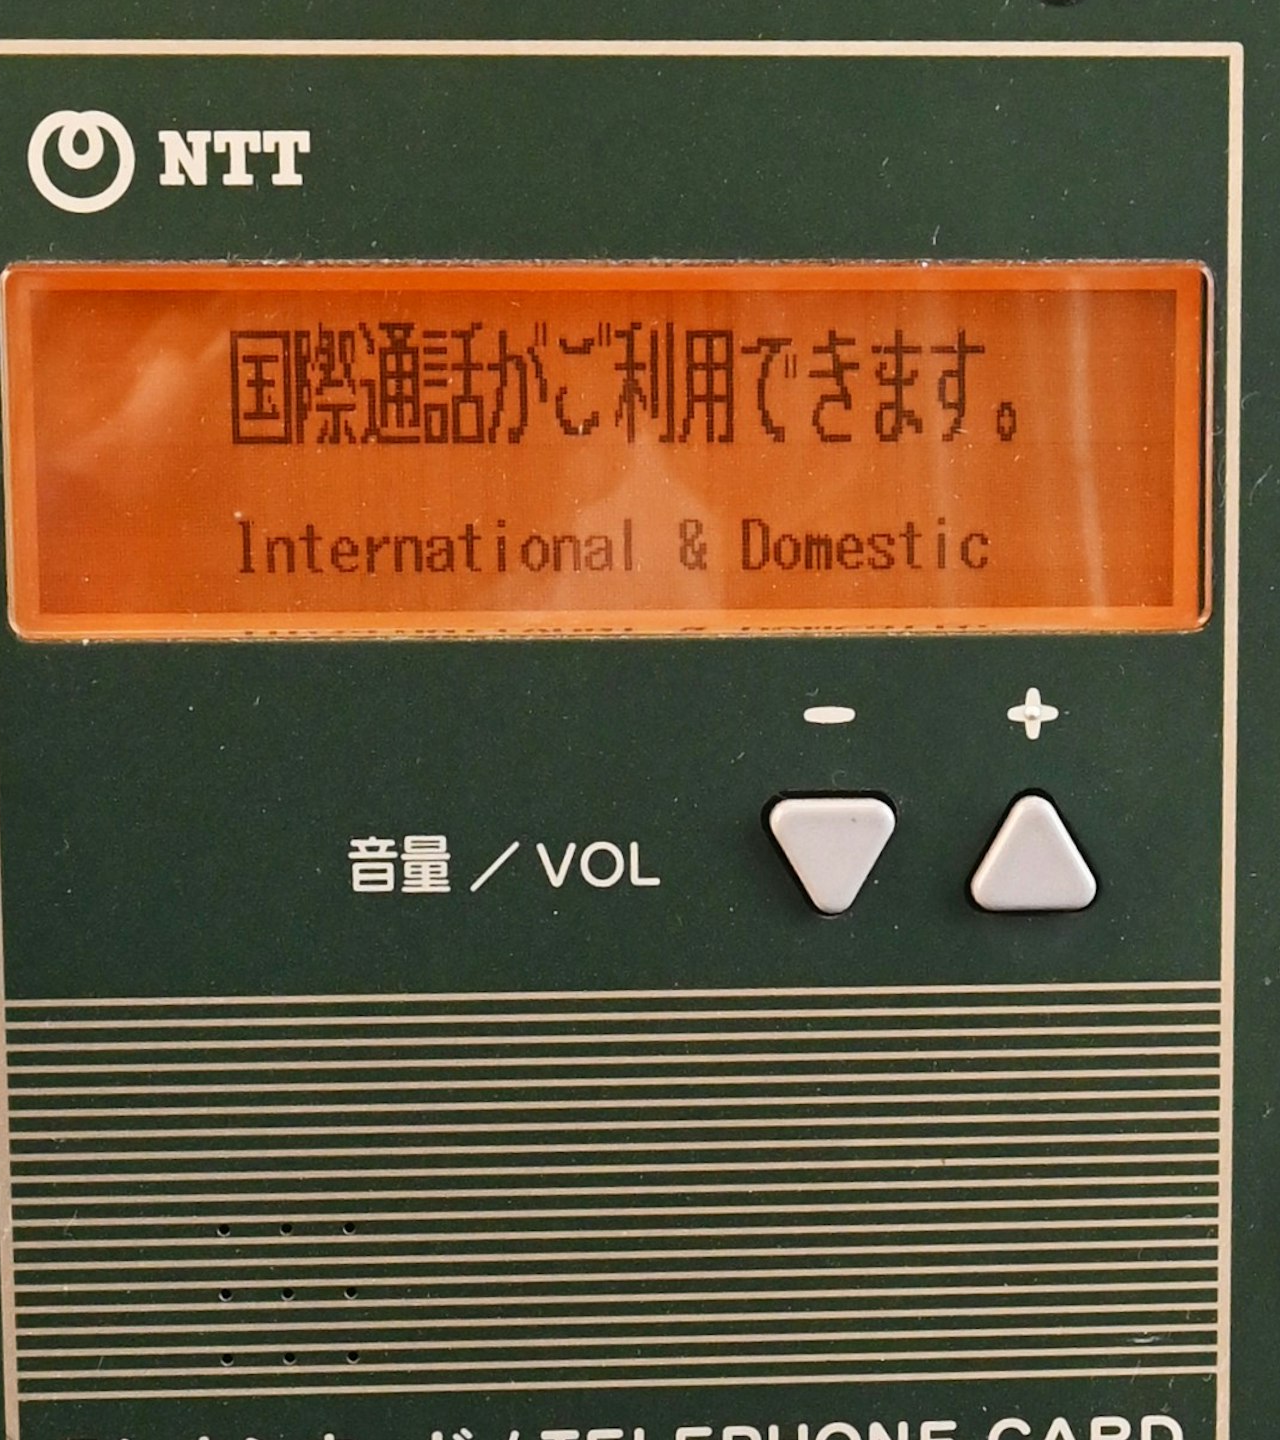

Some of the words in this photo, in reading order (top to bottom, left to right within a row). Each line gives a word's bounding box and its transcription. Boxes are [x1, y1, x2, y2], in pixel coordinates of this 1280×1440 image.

[159, 131, 310, 185] NTT
[230, 320, 1016, 445] 国際通話がご利用できます。
[237, 515, 637, 574] International
[680, 519, 707, 570] &
[742, 518, 988, 570] Domestic
[348, 836, 450, 892] 音量
[537, 842, 660, 887] VOL
